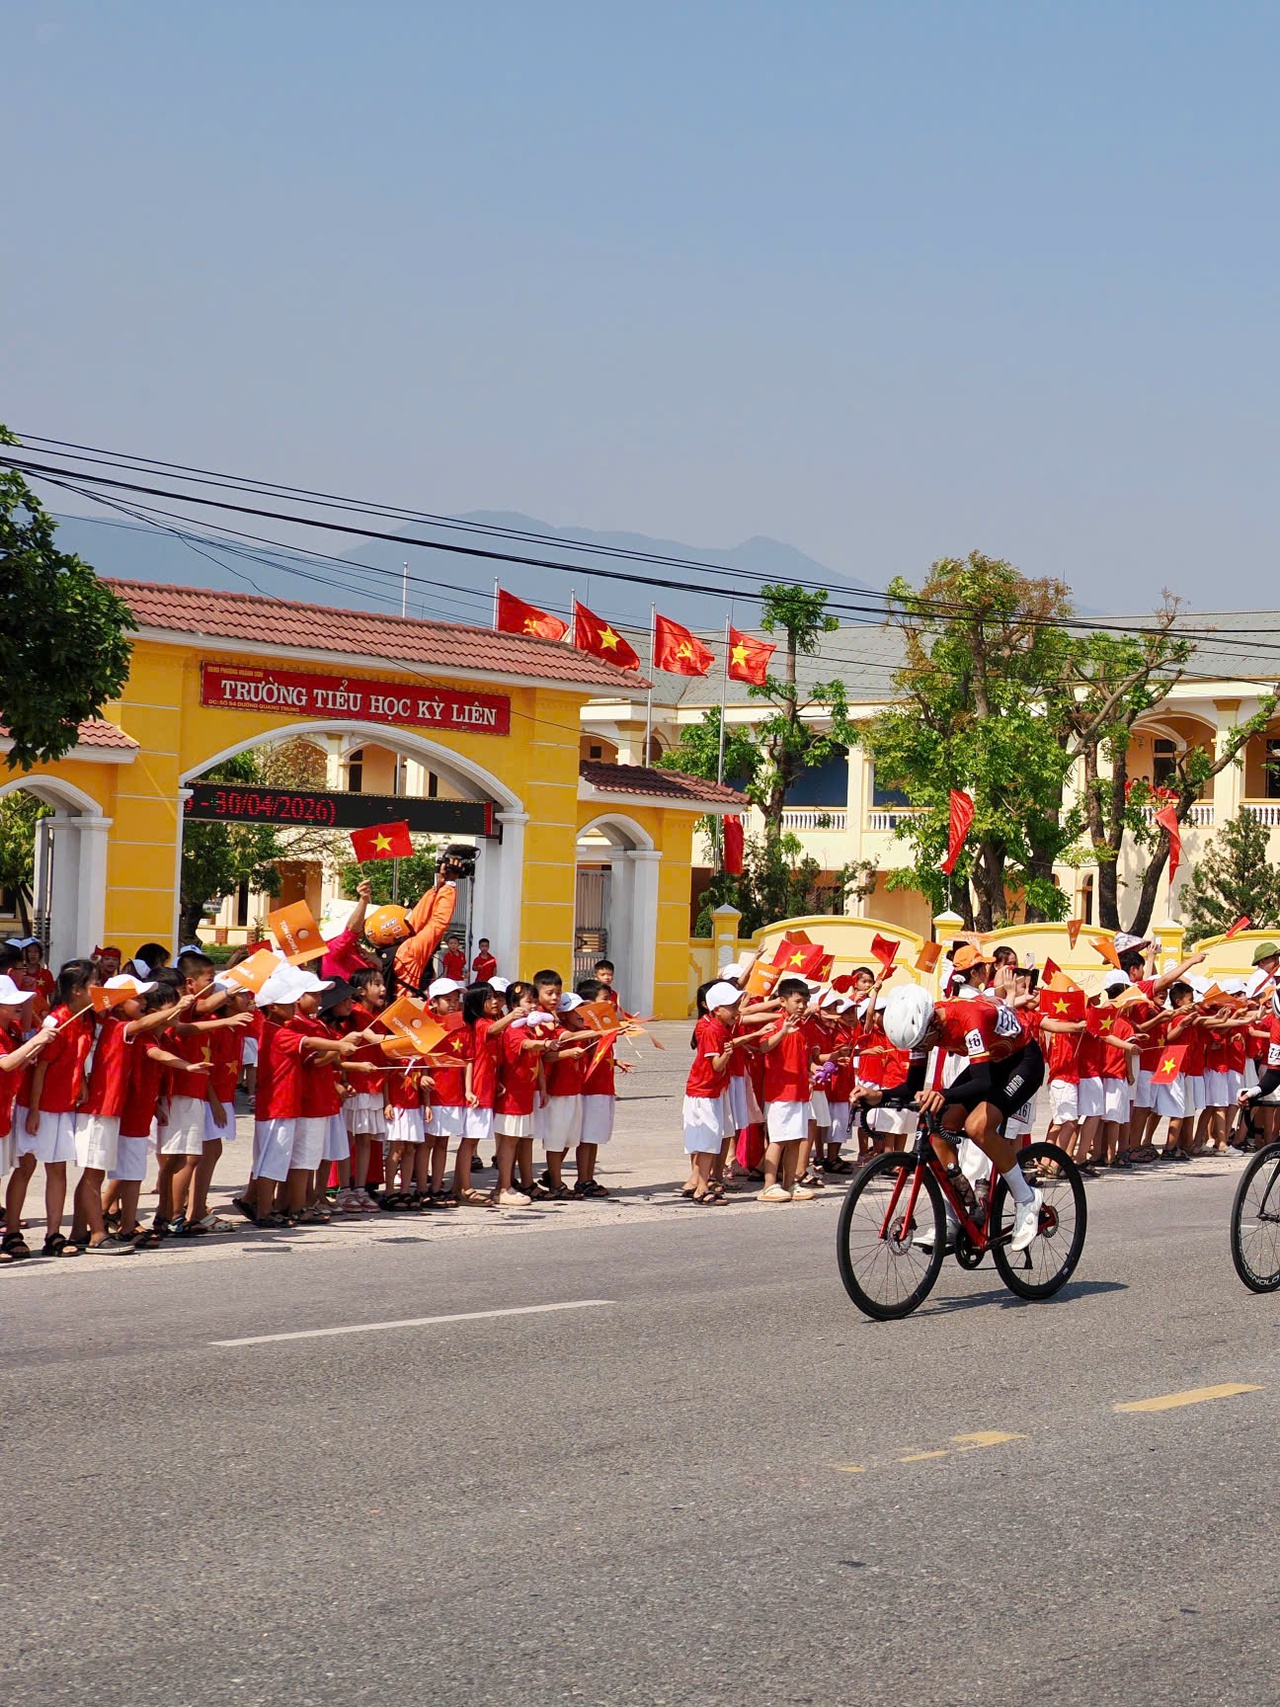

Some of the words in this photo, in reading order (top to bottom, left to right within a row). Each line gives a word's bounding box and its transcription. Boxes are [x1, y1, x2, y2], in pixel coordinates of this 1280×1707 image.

[221, 676, 308, 706] TRƯỜNG
[313, 679, 362, 712] TIỂU
[369, 695, 411, 720] HỌC
[417, 696, 445, 720] KỲ
[451, 701, 497, 726] LIÊN
